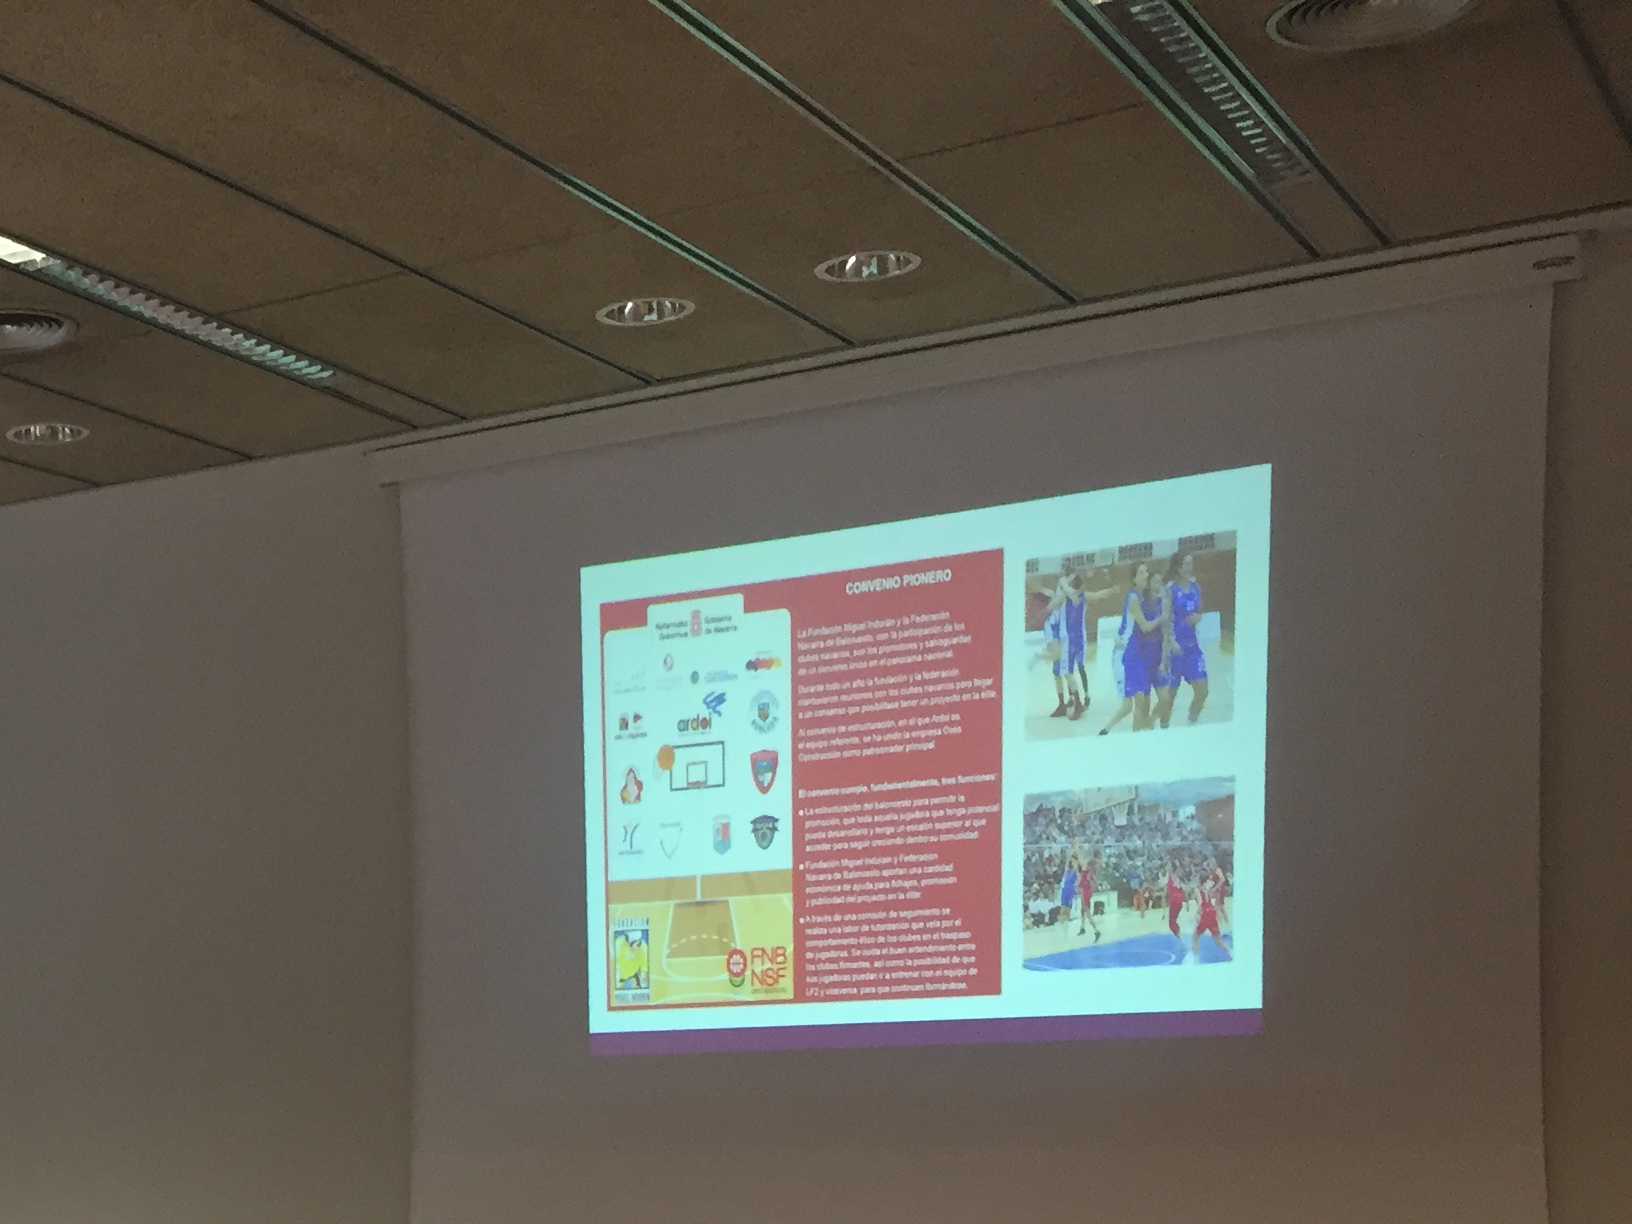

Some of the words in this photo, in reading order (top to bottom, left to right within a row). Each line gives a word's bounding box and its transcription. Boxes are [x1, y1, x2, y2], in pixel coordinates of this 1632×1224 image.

[846, 576, 900, 595] CONVENIO
[903, 569, 951, 587] PIONERO
[677, 712, 712, 732] ardoi
[750, 946, 787, 966] FNB
[750, 967, 787, 987] NSF
